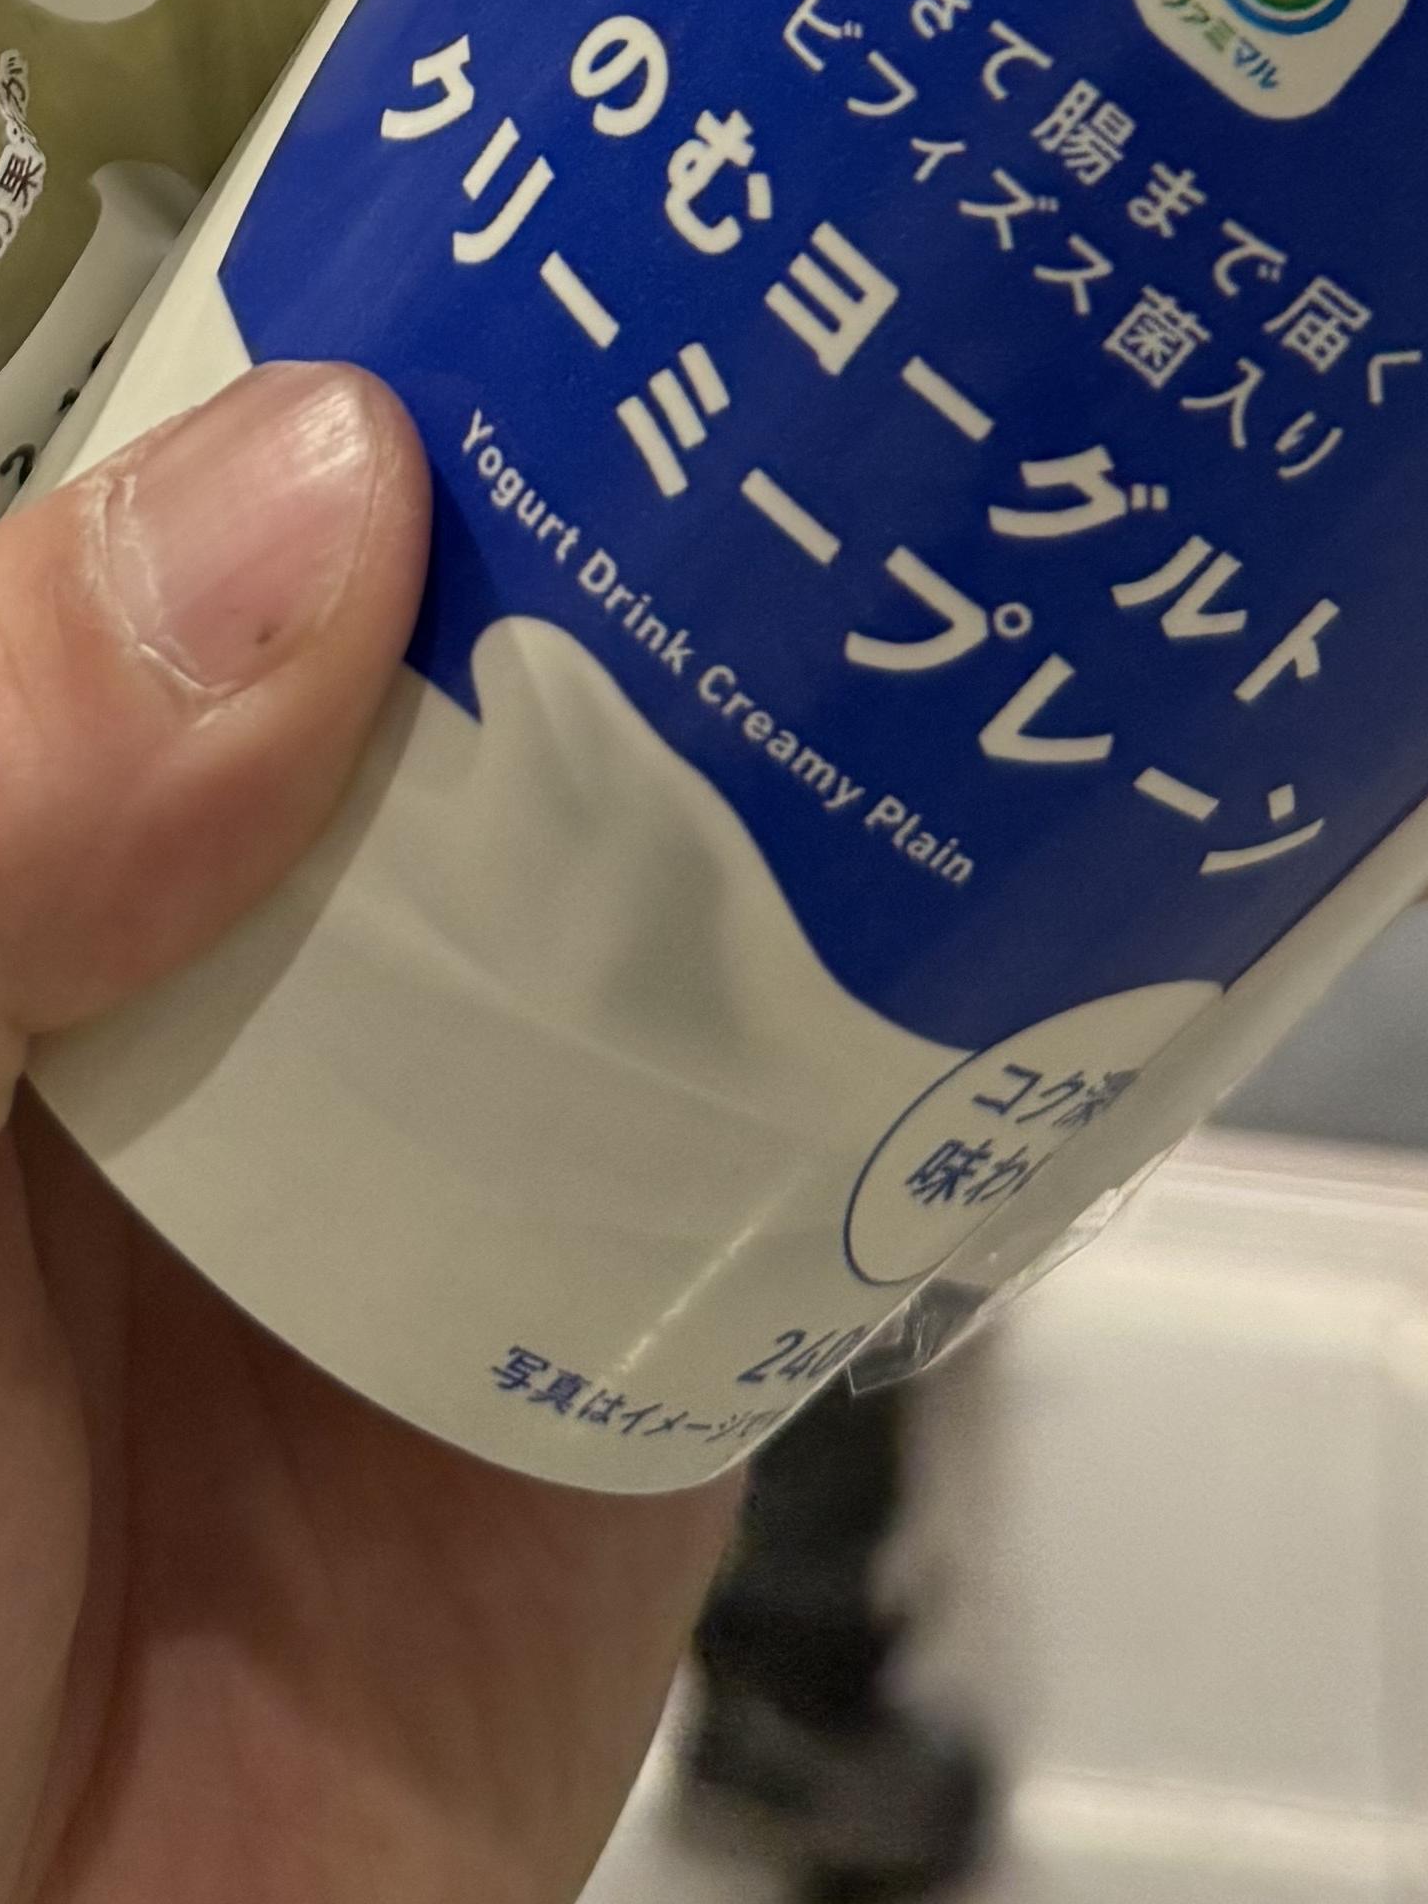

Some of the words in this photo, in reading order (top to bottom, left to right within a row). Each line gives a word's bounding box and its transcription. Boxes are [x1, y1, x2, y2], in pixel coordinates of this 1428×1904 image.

[380, 33, 1325, 874] クリーミープレーン
[461, 408, 580, 564] Yogurt
[577, 548, 694, 674] Drink
[698, 664, 864, 813] Creamy
[864, 795, 974, 884] Plain
[569, 14, 1340, 703] のむヨーグルト
